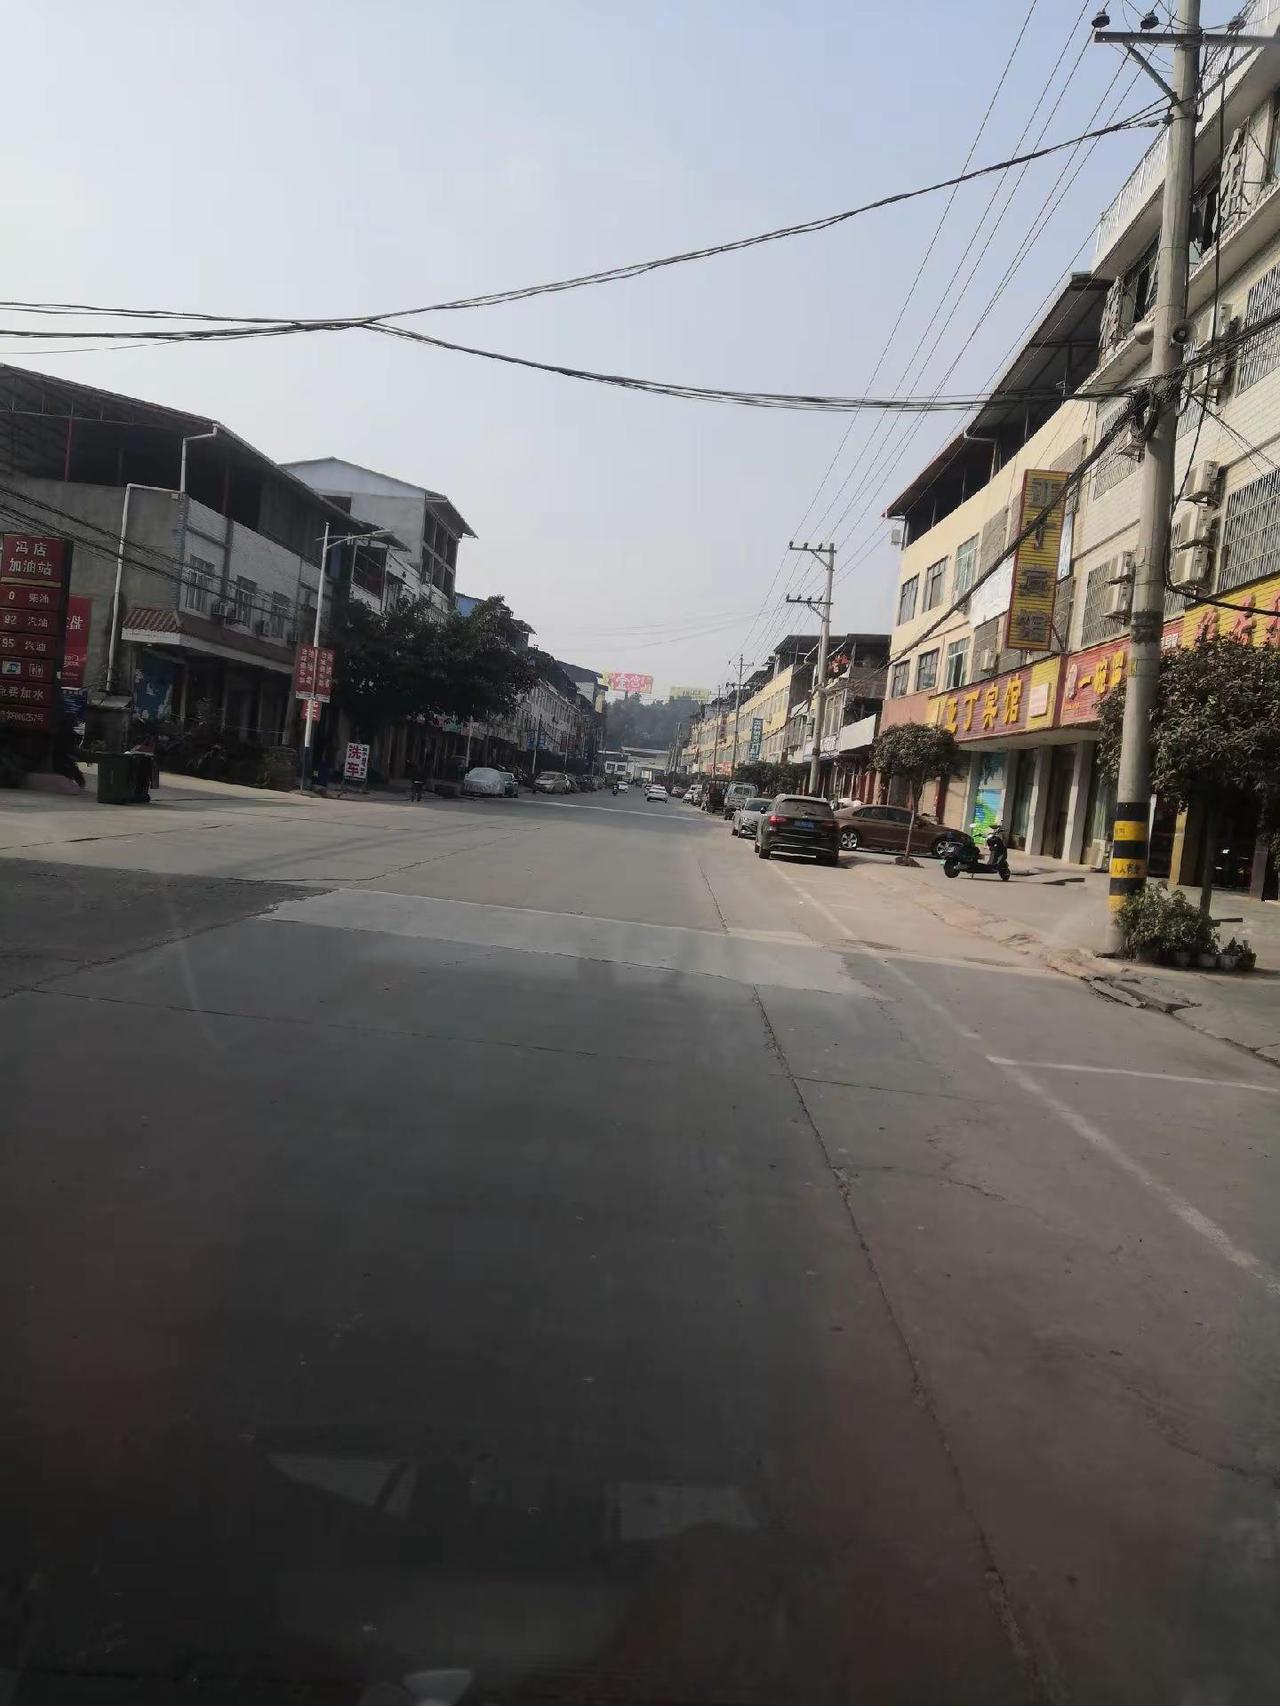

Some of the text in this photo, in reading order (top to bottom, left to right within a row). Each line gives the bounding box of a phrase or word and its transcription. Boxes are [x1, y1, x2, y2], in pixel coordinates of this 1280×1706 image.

[15, 540, 48, 557] 冯店
[9, 558, 52, 577] 加油站
[4, 614, 48, 628] 92 汽油
[1, 638, 15, 648] 95
[944, 673, 1022, 734] 亚丁宾馆
[346, 745, 361, 776] 洗车
